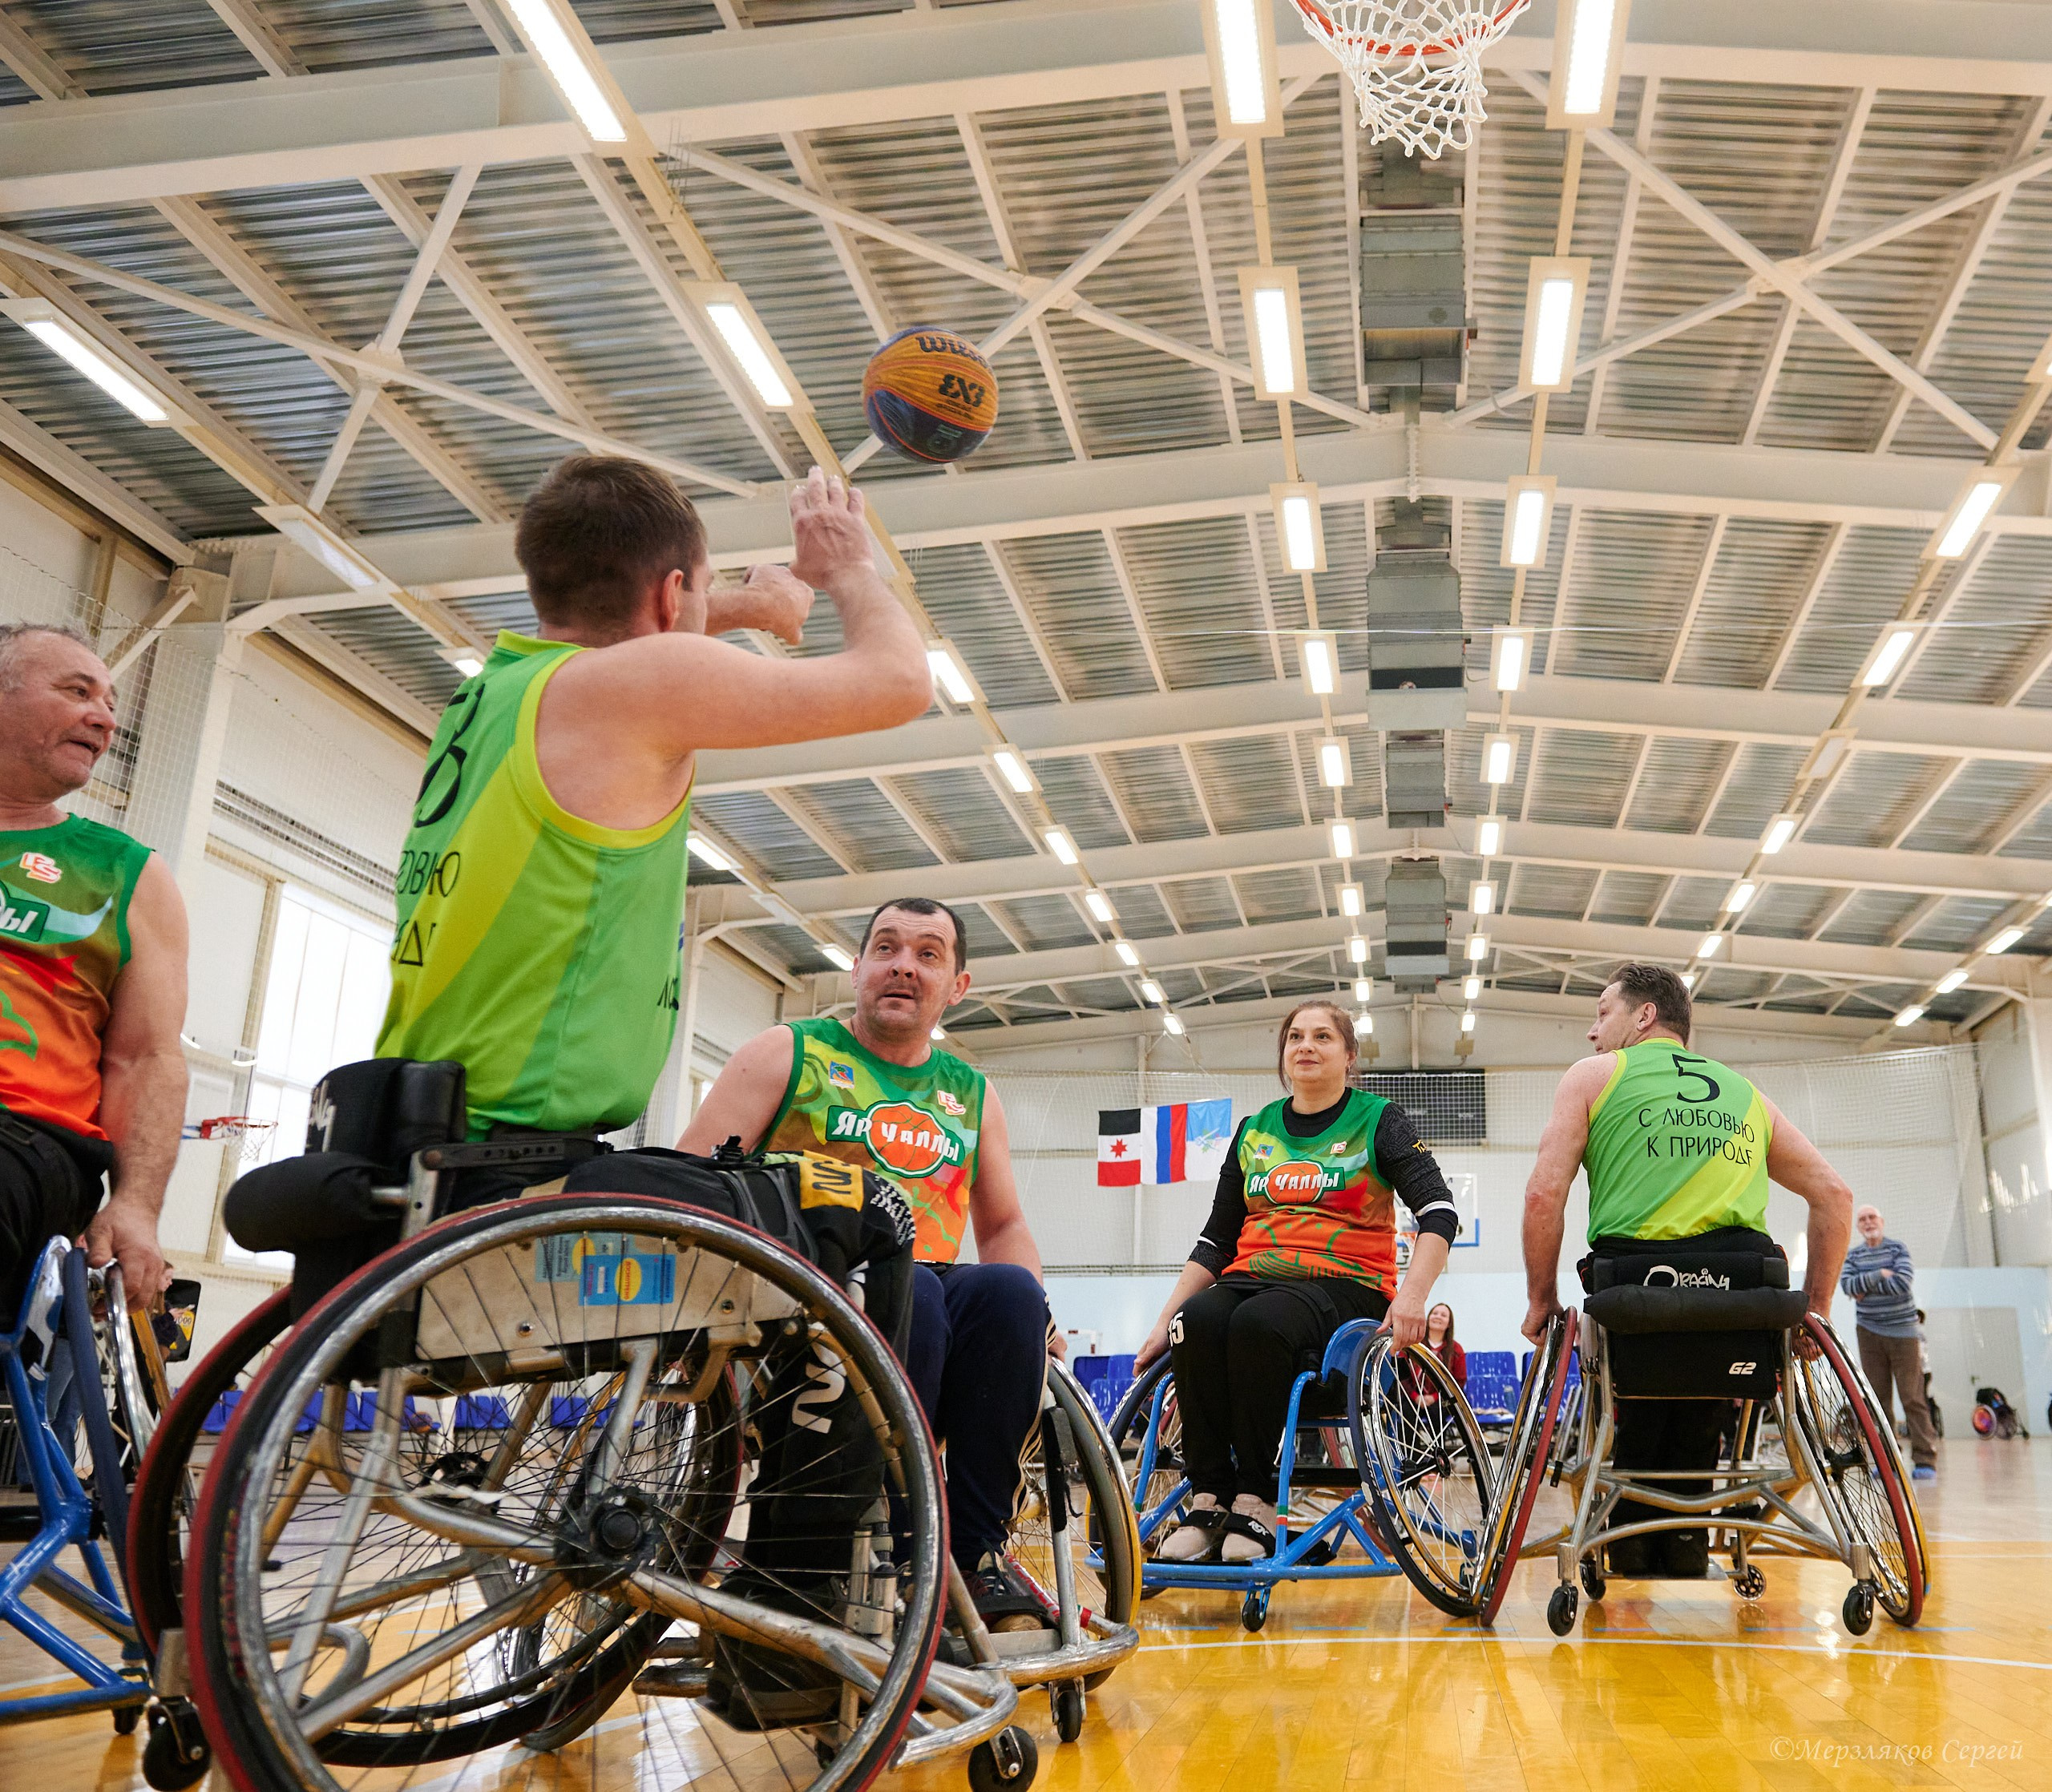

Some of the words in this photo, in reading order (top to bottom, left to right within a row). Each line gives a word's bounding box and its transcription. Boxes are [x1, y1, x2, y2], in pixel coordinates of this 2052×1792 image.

[1671, 1053, 1721, 1104] 5
[1638, 1108, 1652, 1128] С
[1662, 1108, 1755, 1143] ЛЮБОВЬЮ
[1647, 1136, 1660, 1158] К
[1670, 1136, 1753, 1168] ПРИРОДЕ
[1728, 1362, 1757, 1375] G2
